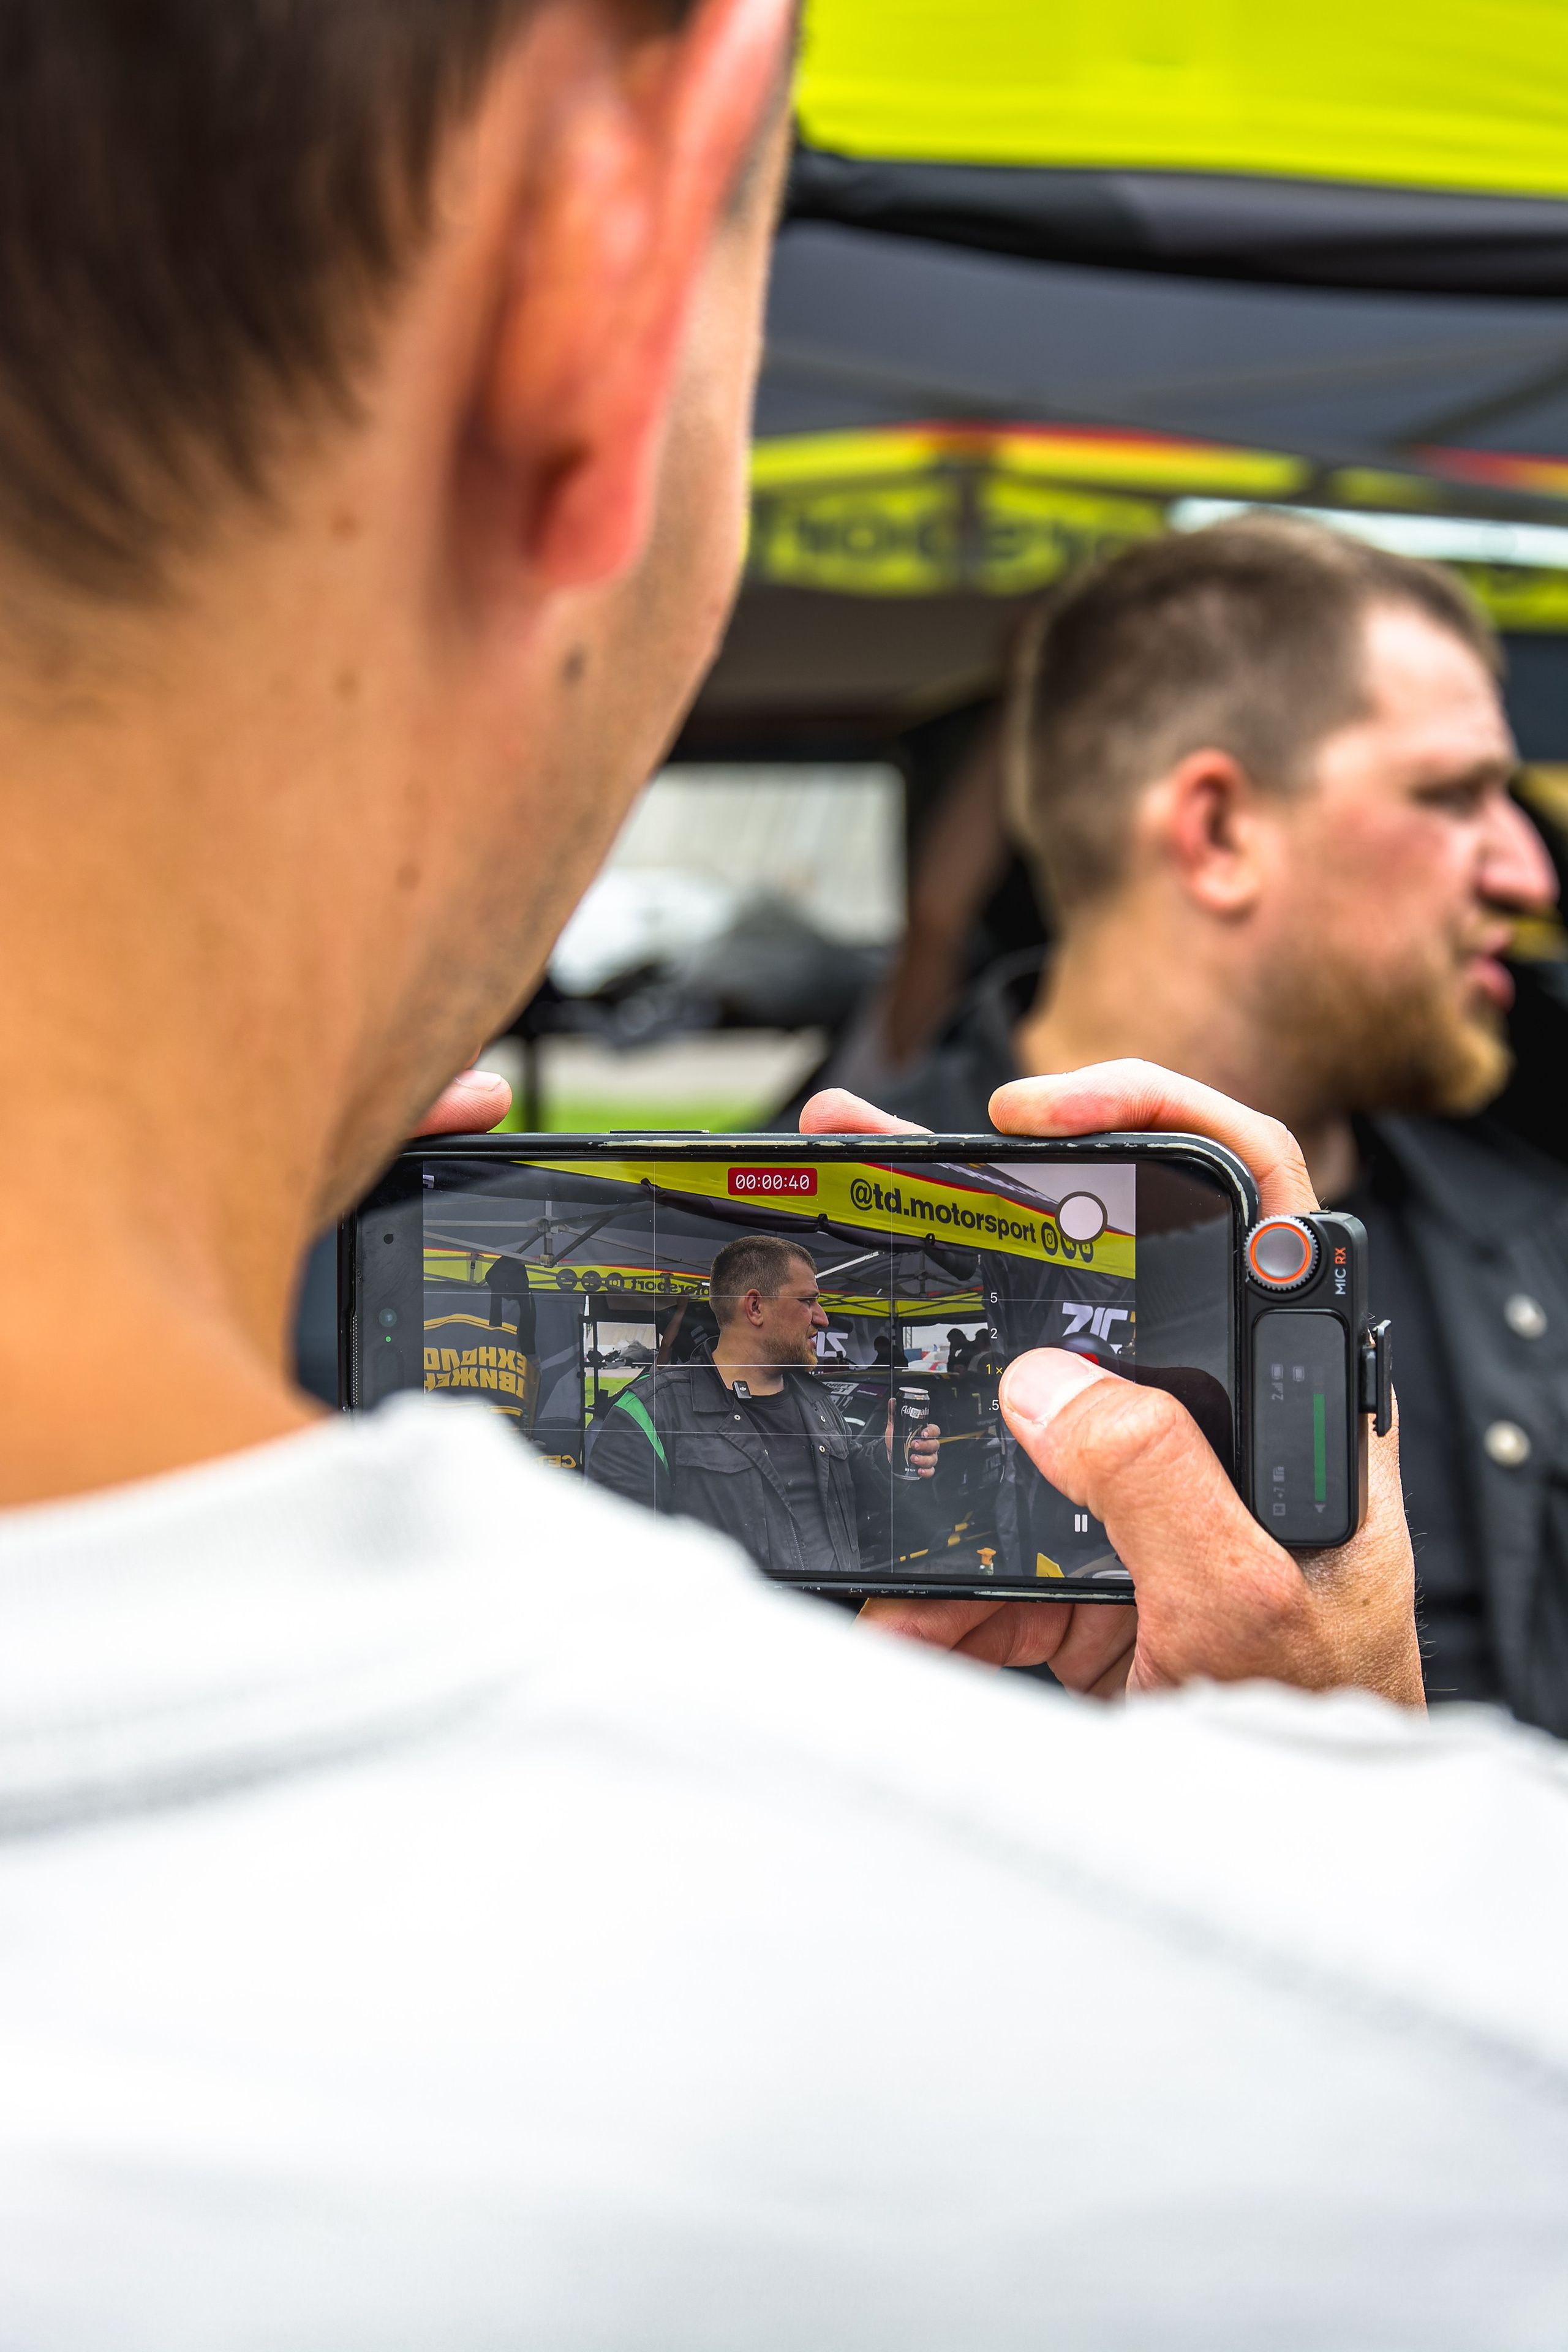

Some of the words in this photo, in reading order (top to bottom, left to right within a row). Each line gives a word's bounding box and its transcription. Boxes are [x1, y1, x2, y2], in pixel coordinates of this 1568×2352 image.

[736, 1174, 810, 1189] 00:00:40
[850, 1178, 1036, 1244] @td.motorsport
[1335, 1247, 1346, 1264] RX
[1335, 1268, 1346, 1294] MIC
[990, 1292, 998, 1303] 5
[990, 1328, 998, 1339] 2
